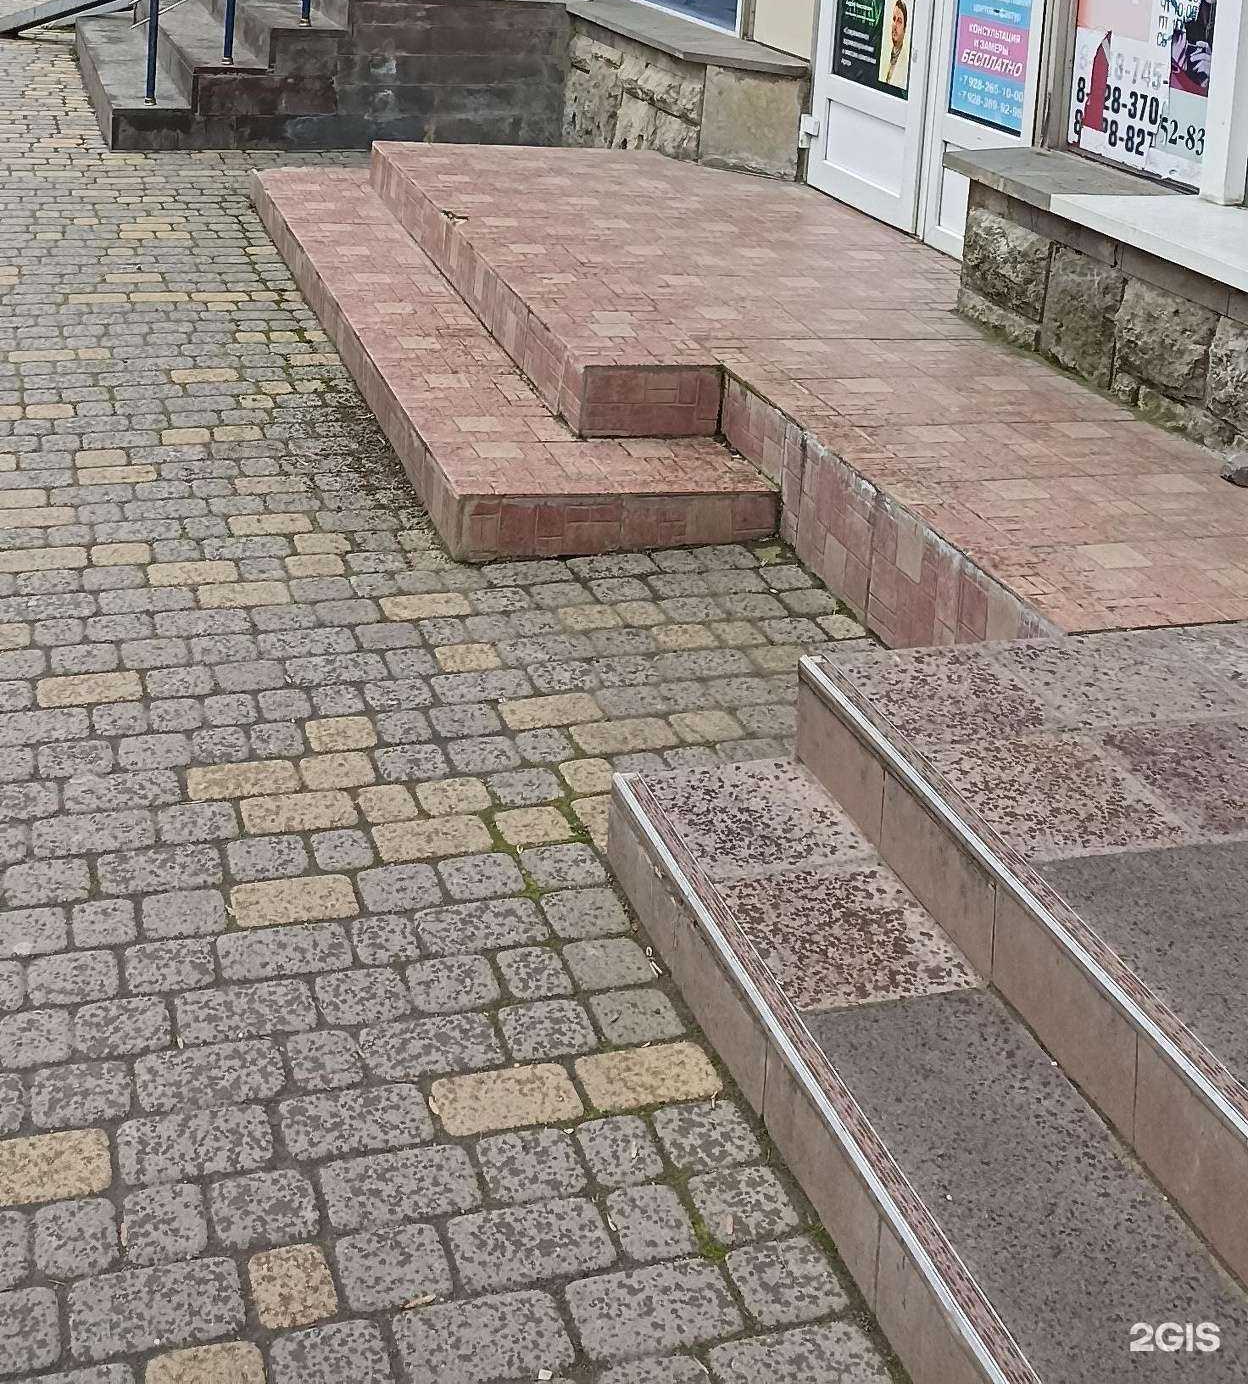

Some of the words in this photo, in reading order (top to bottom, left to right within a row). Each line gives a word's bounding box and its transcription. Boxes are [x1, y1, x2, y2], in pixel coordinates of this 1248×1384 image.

[969, 23, 1021, 44] КОНСУЛЬТАЦИЯ
[980, 40, 1009, 56] ЗАМЕРЫ
[961, 48, 1023, 77] БЕСПЛАТНО
